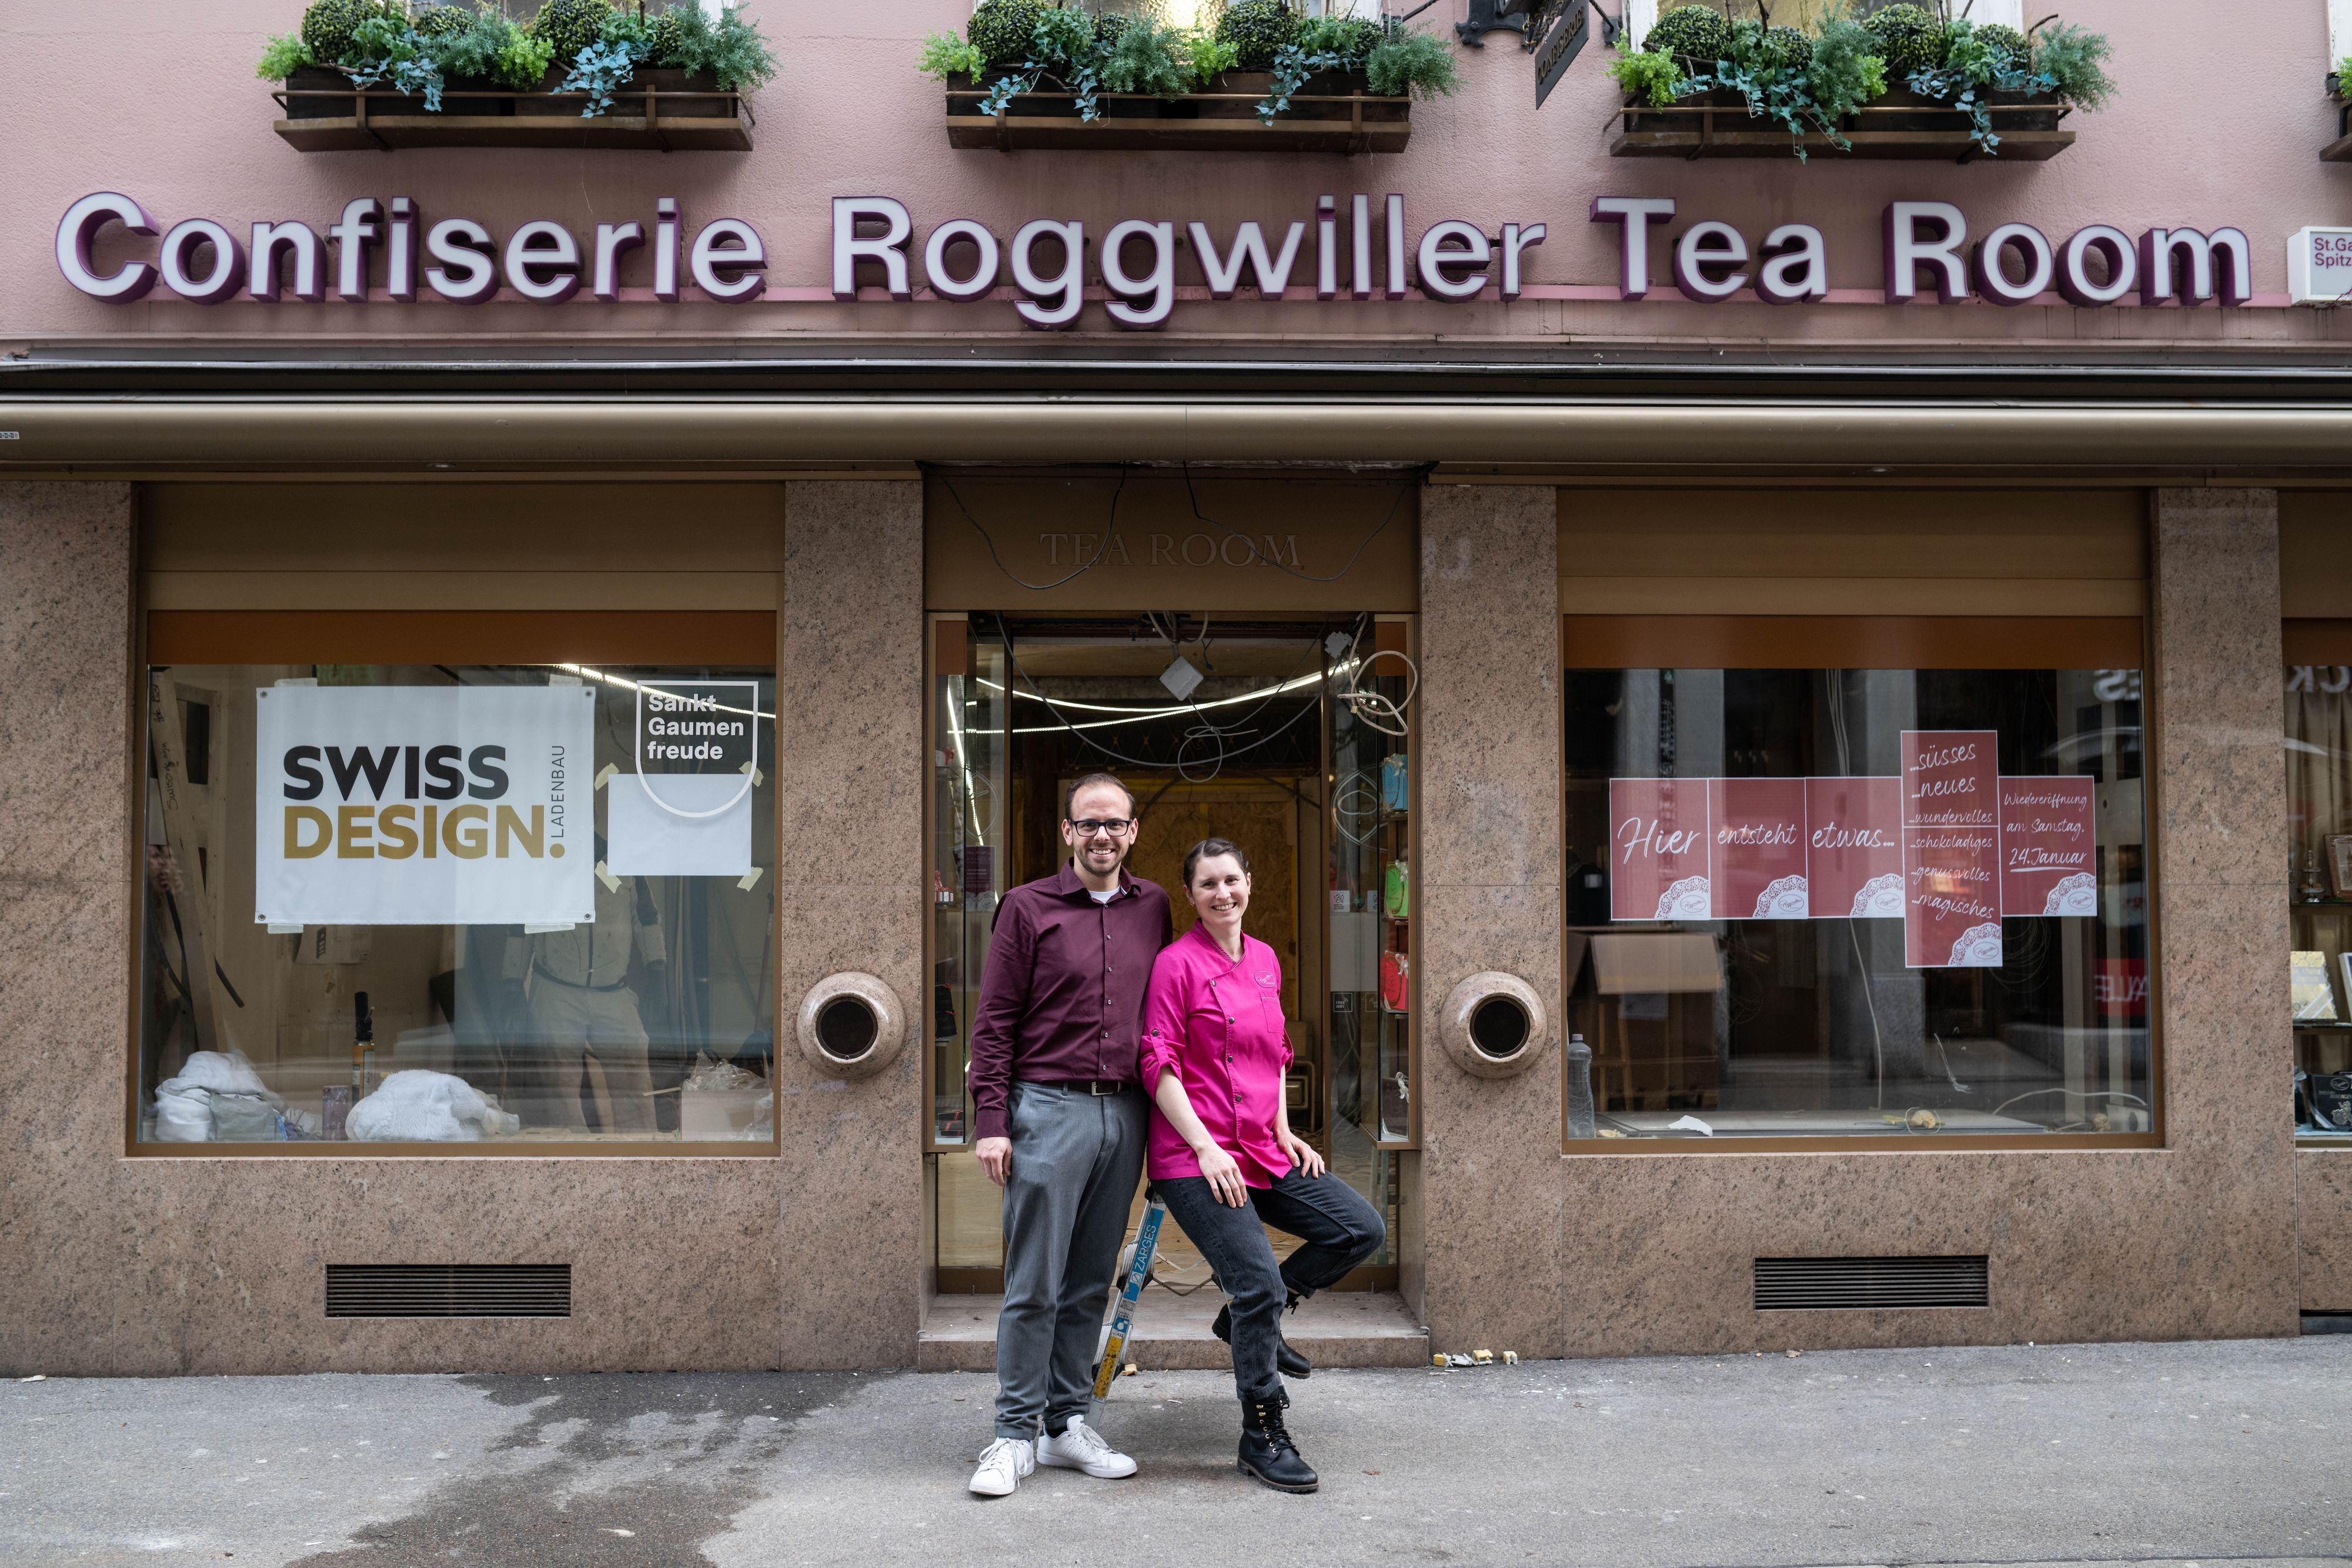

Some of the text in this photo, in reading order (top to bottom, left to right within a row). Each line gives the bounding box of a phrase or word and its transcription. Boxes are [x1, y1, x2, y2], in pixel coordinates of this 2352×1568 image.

[56, 191, 2251, 330] Confiserie Roggwiller Tea Room
[1040, 533, 1304, 567] TEA ROOM
[649, 694, 716, 712] Sankt
[648, 717, 744, 735] Gaumen
[647, 741, 723, 759] freude
[283, 745, 509, 801] SWISS
[550, 745, 565, 838] LADENBAU
[2004, 793, 2087, 812] Wiedereröffnung
[1618, 817, 1701, 865] Hier
[1718, 824, 1798, 845] entsteht
[2007, 823, 2026, 833] am
[1135, 1225, 1156, 1272] ZARGES
